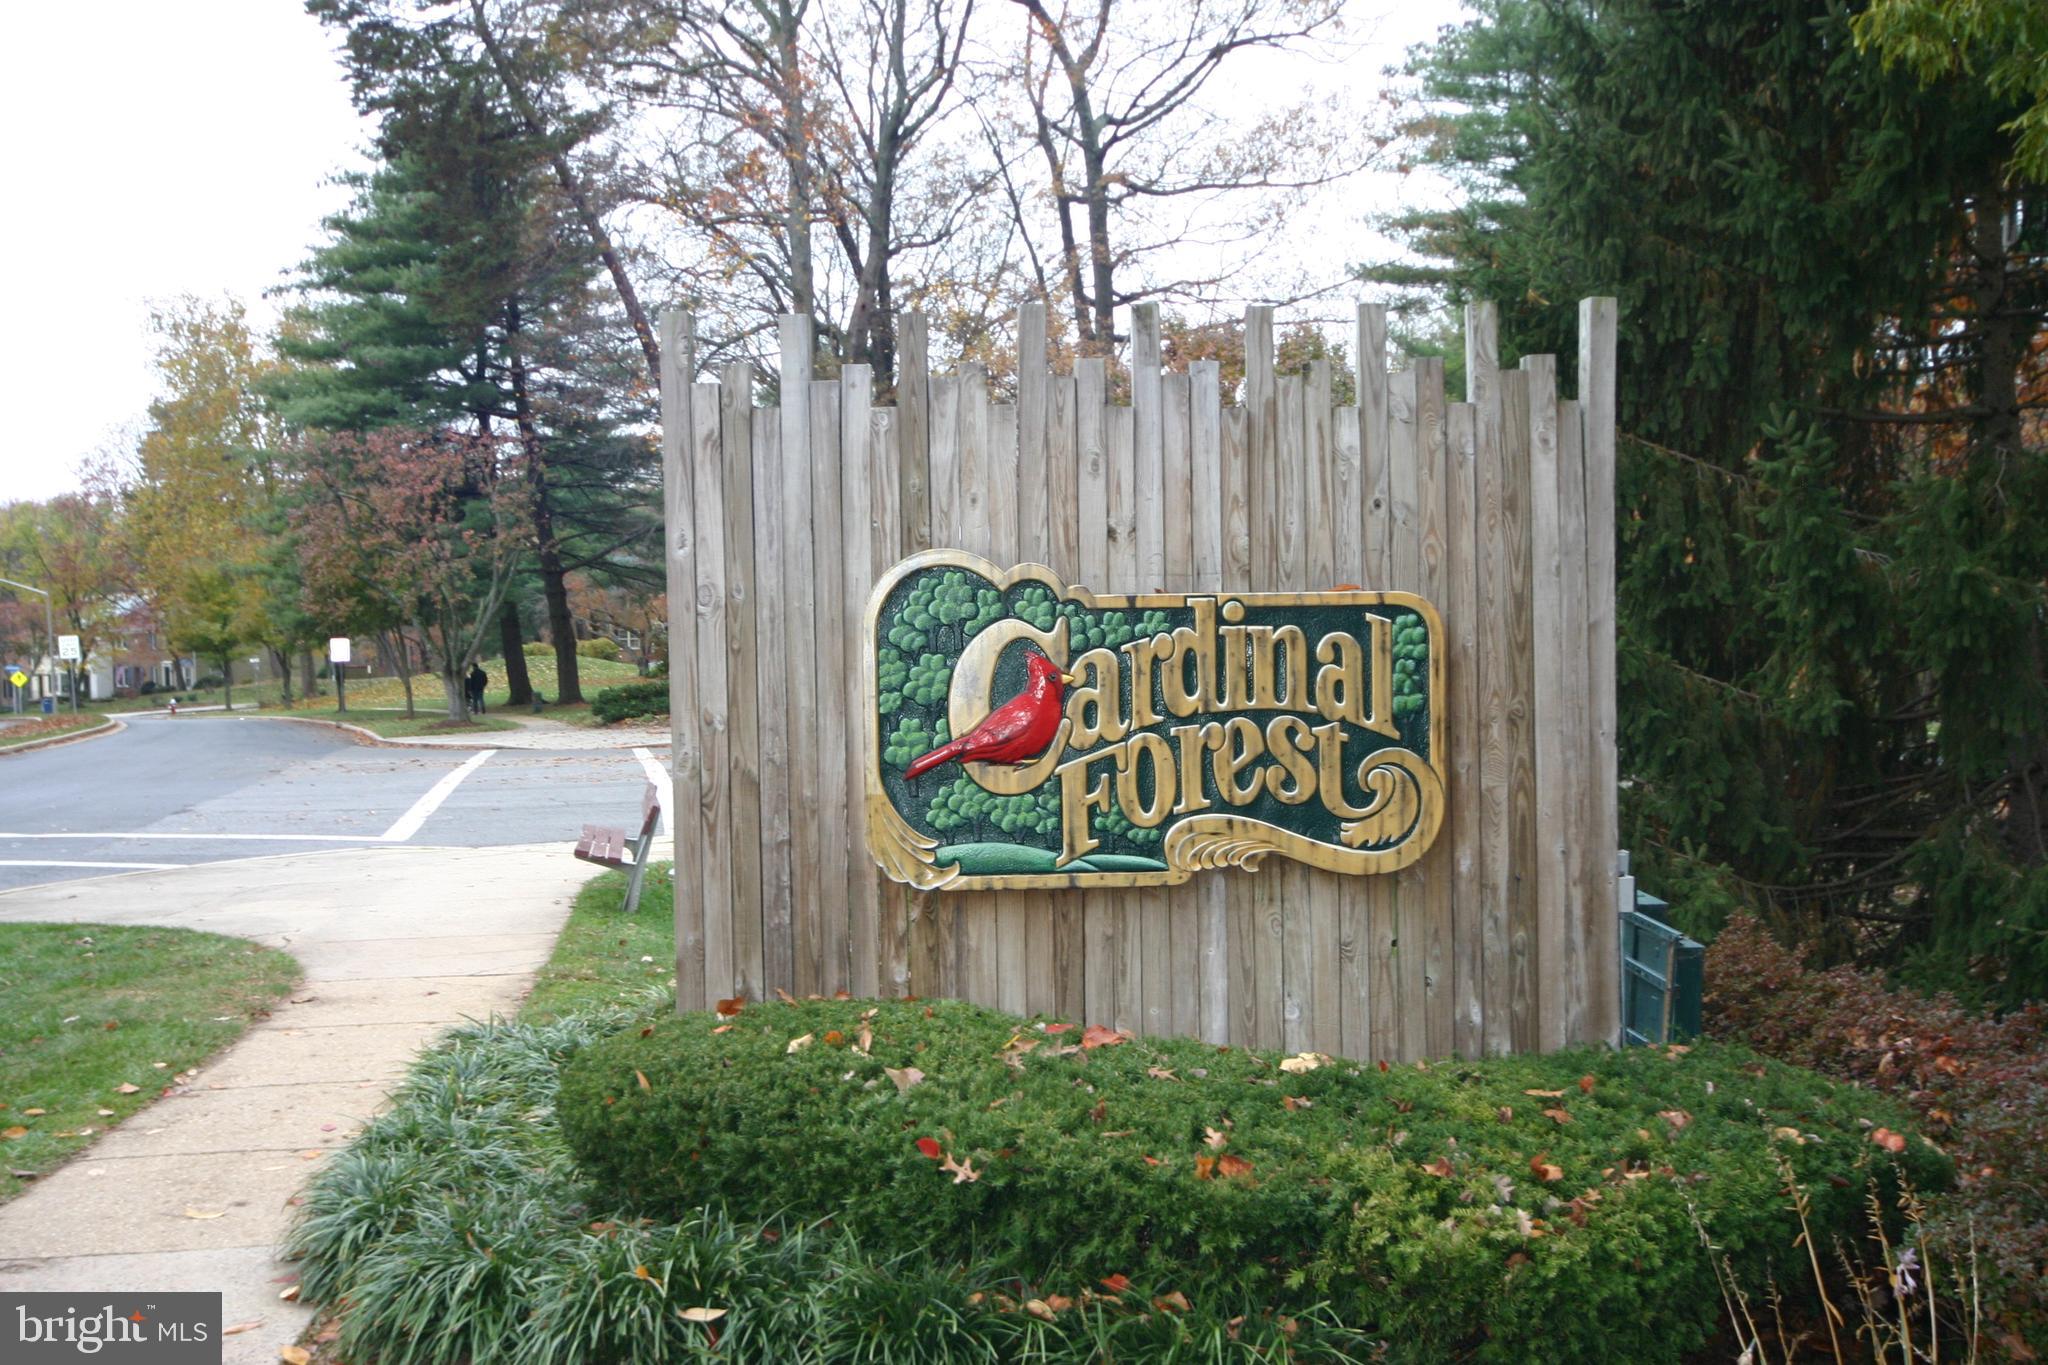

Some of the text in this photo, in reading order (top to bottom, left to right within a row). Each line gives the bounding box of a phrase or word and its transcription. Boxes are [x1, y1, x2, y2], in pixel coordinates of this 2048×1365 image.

[62, 648, 77, 656] 25
[948, 597, 1400, 796] Cardinal
[1055, 715, 1390, 868] Forest
